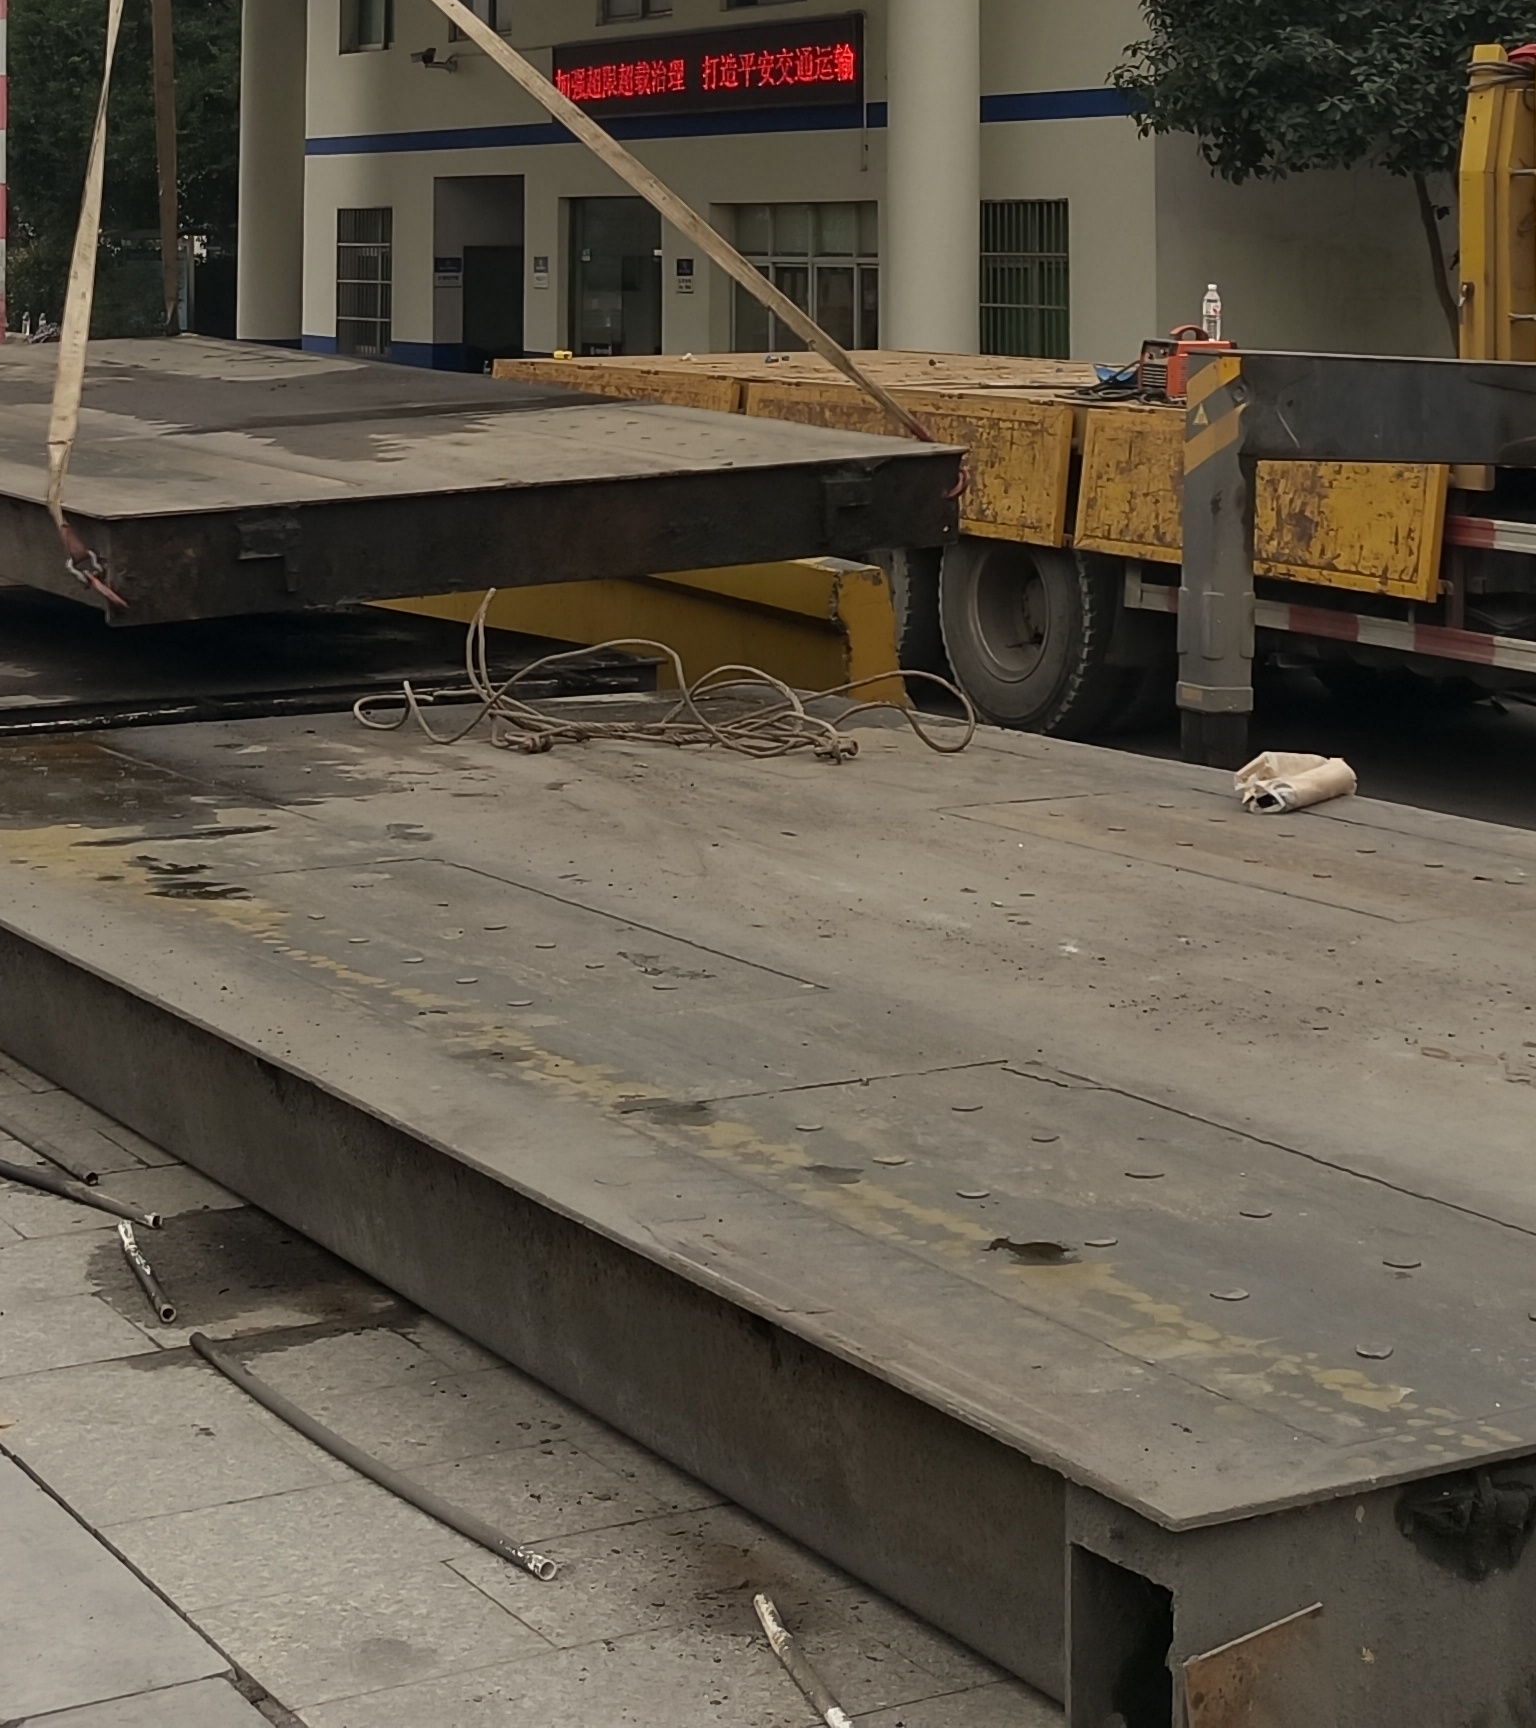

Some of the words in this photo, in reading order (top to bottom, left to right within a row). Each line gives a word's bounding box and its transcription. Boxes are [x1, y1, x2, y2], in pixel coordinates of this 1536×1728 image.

[701, 42, 856, 92] 打造平安交通运输
